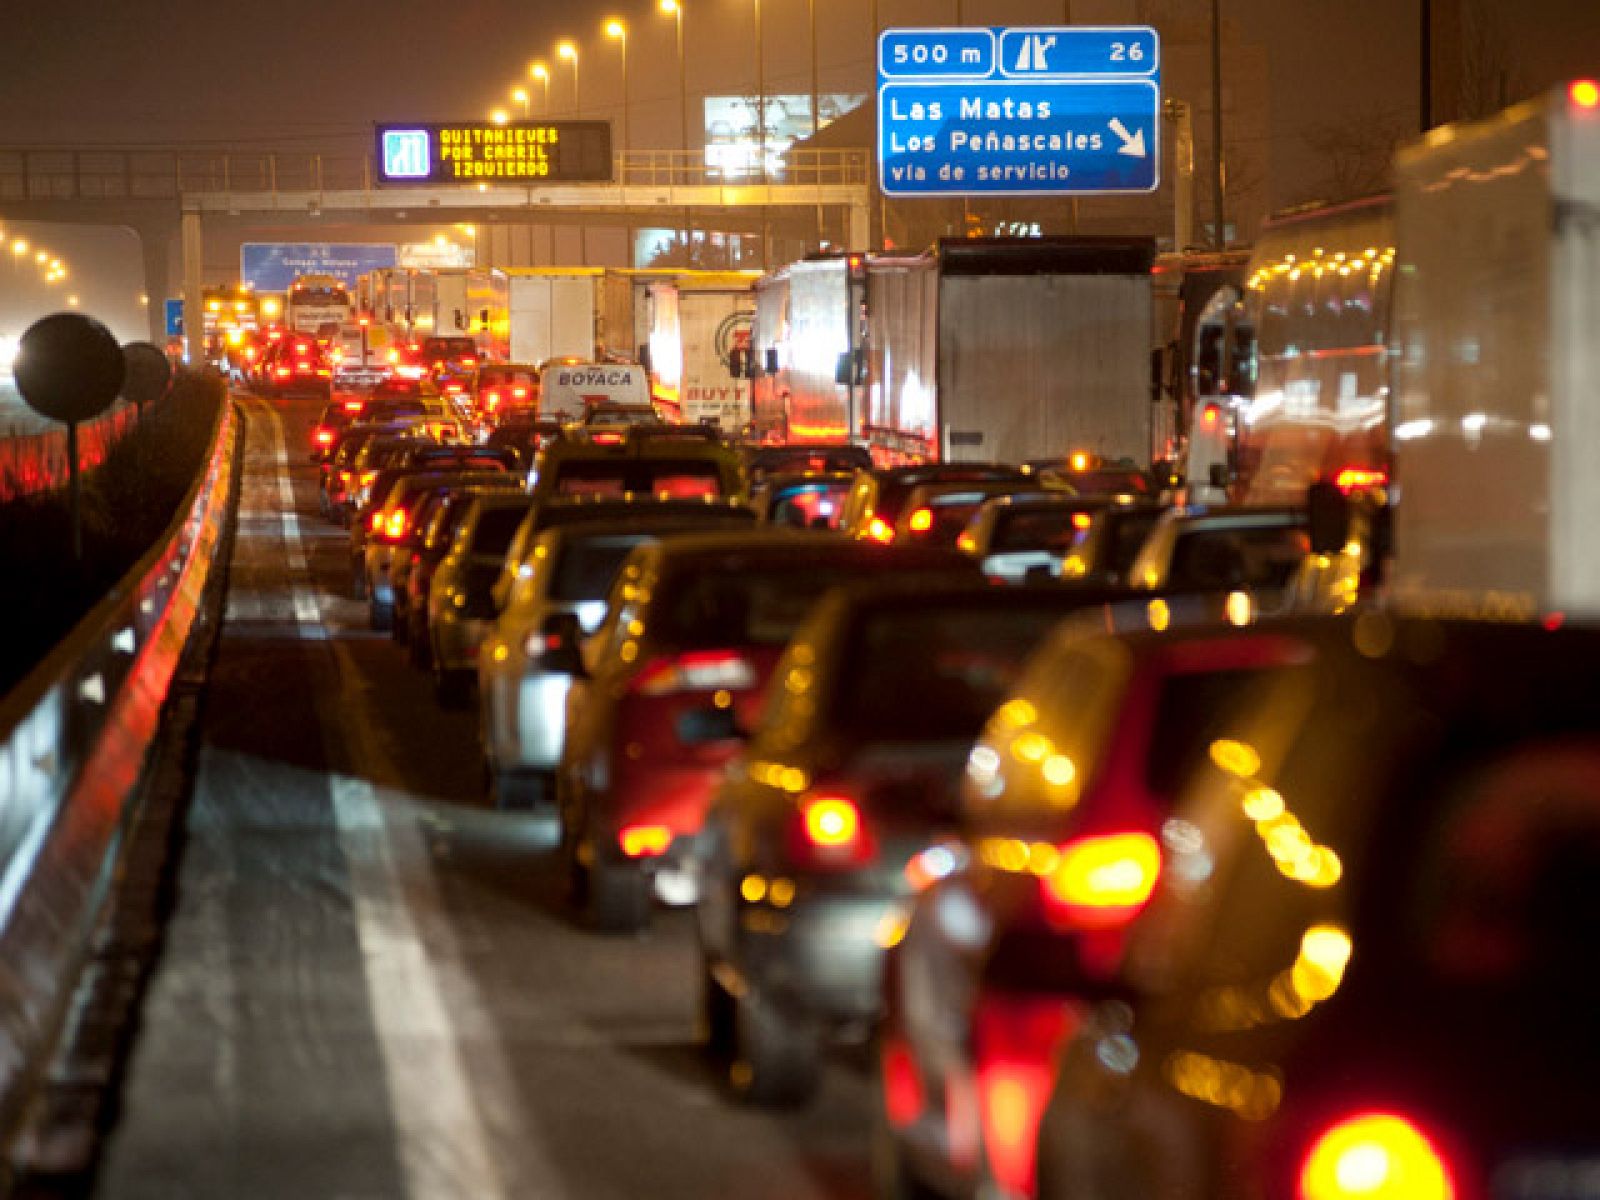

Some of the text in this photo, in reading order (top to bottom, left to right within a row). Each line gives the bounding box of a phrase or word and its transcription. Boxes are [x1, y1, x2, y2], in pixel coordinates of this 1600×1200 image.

[894, 44, 981, 63] 500 m
[1109, 42, 1144, 61] 26
[890, 97, 1051, 120] Las Matas
[890, 130, 1103, 152] Los Peñascales
[939, 162, 964, 181] de
[976, 162, 1069, 181] servicio
[559, 372, 632, 385] BOYACA
